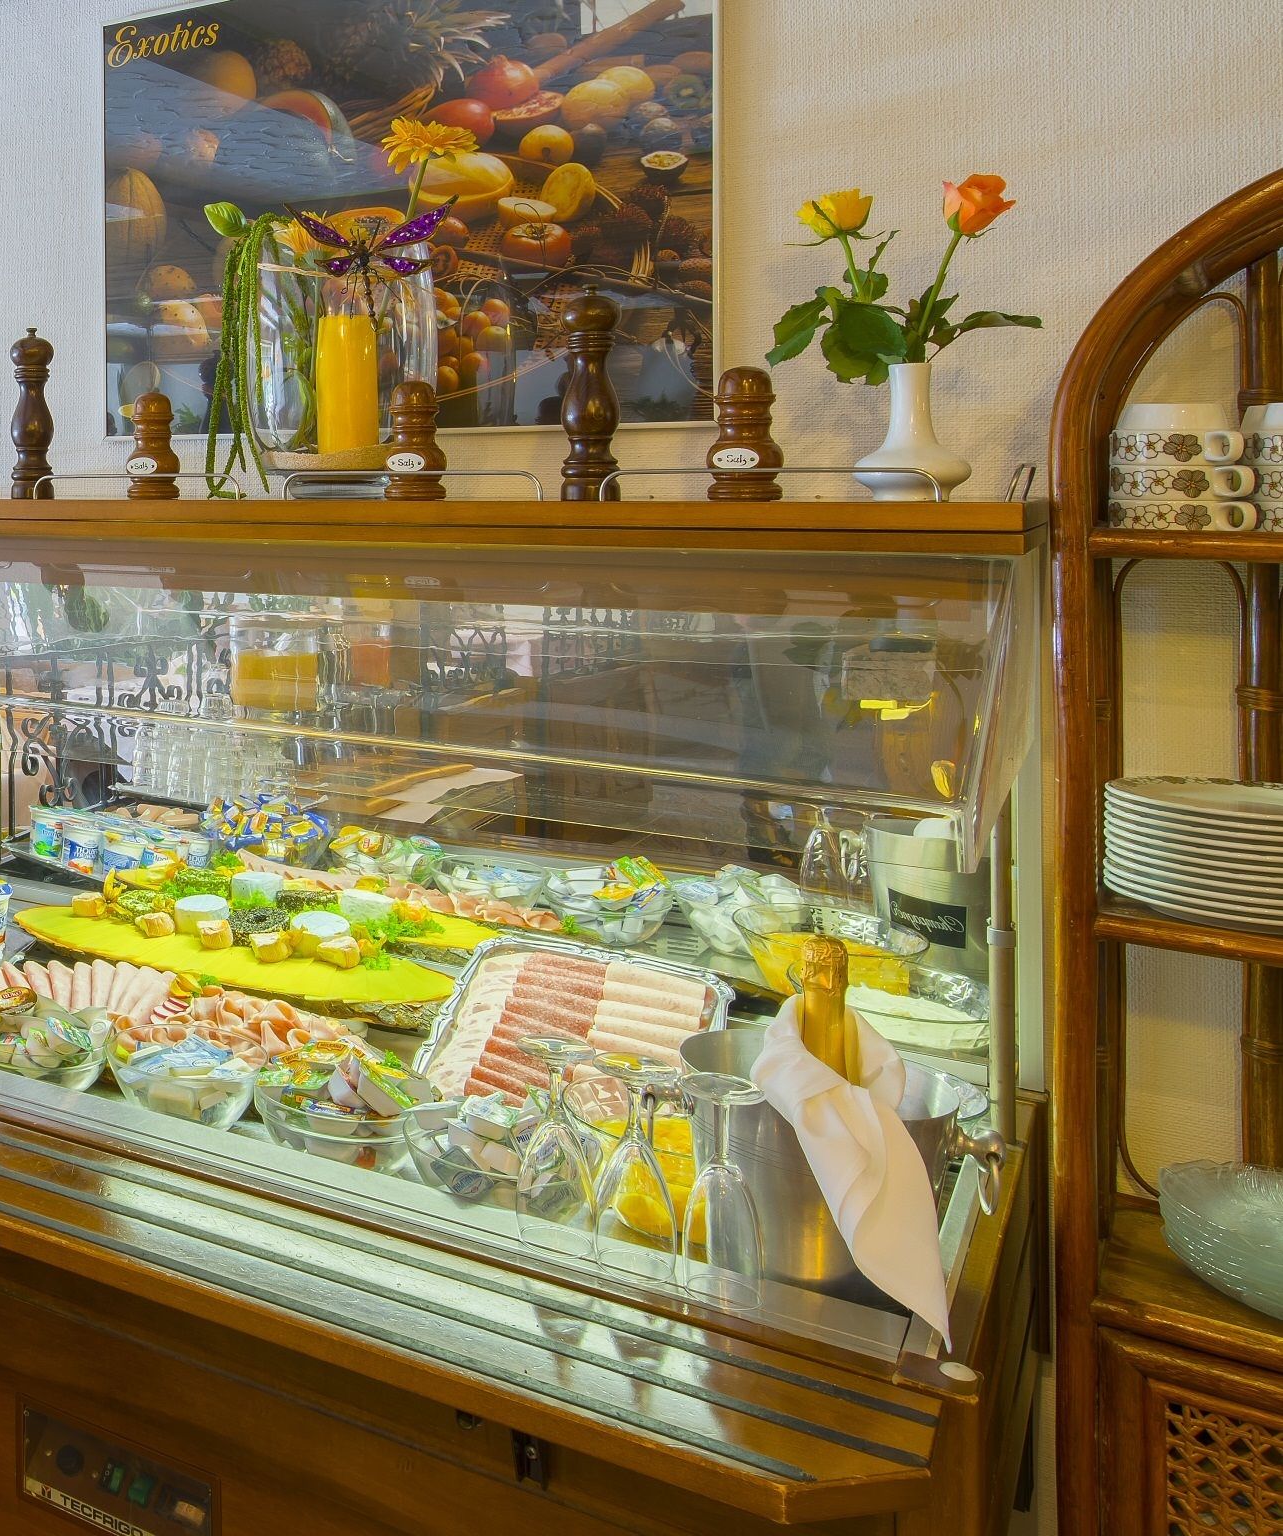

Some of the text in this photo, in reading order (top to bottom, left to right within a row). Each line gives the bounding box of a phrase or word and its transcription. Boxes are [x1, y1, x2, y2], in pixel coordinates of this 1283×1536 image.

[107, 19, 220, 68] Exotics
[397, 458, 415, 469] Salz
[60, 1493, 144, 1536] TECFRIGO
